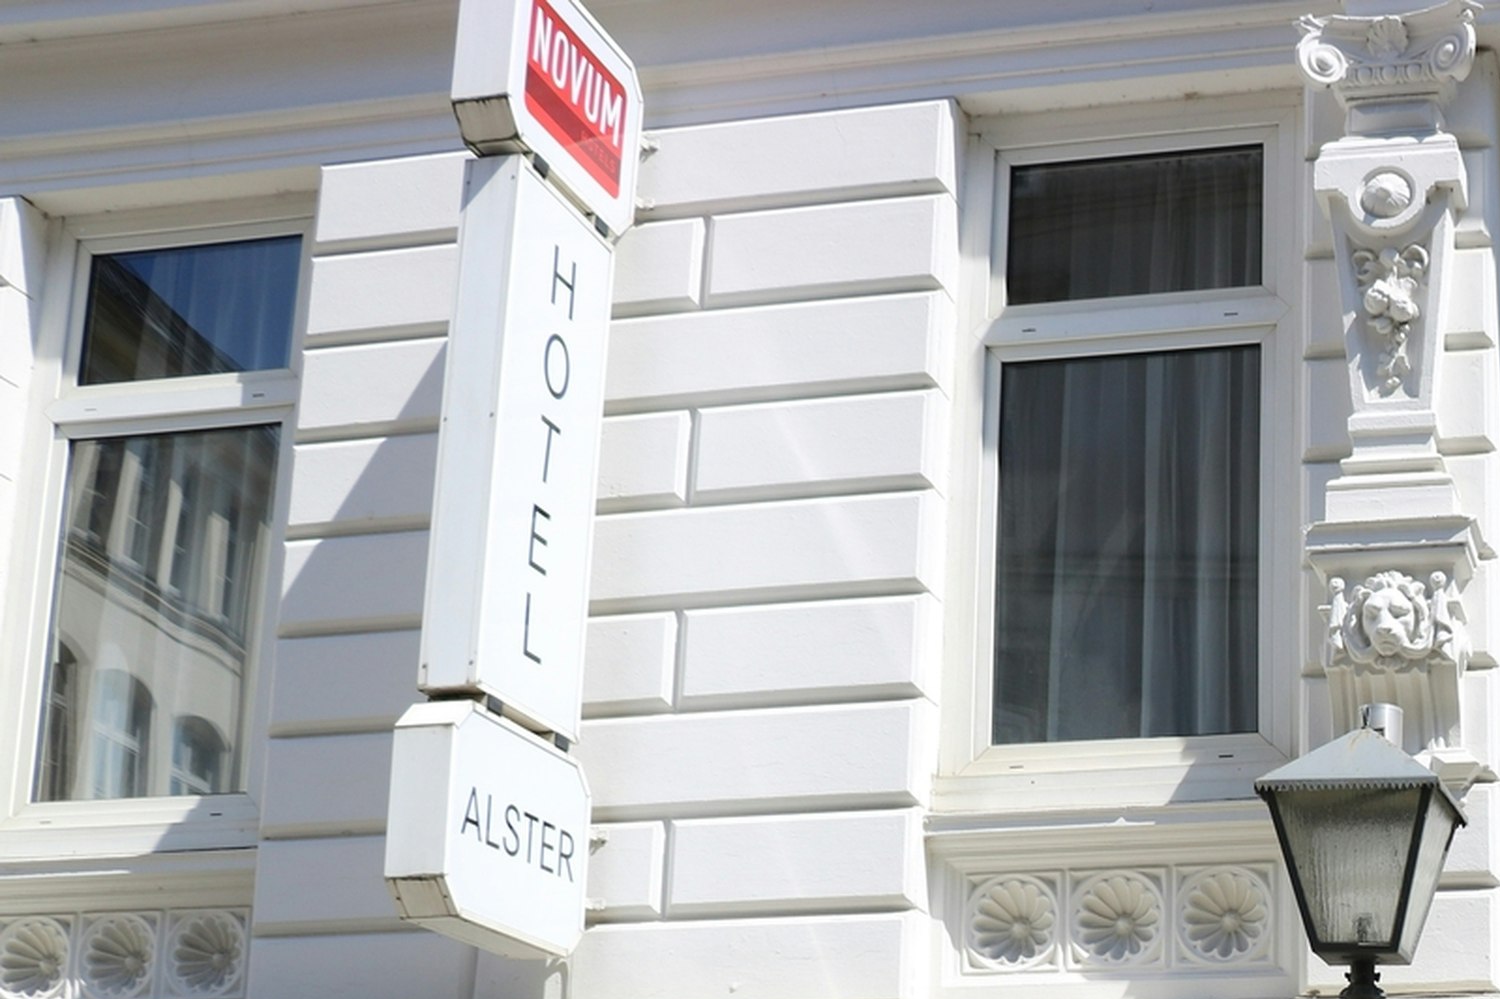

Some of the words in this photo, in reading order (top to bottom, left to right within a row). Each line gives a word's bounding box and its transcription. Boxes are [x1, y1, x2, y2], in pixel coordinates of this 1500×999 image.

[533, 5, 623, 148] NOVUM
[523, 244, 576, 664] HOTEL
[460, 786, 575, 882] ALSTER
